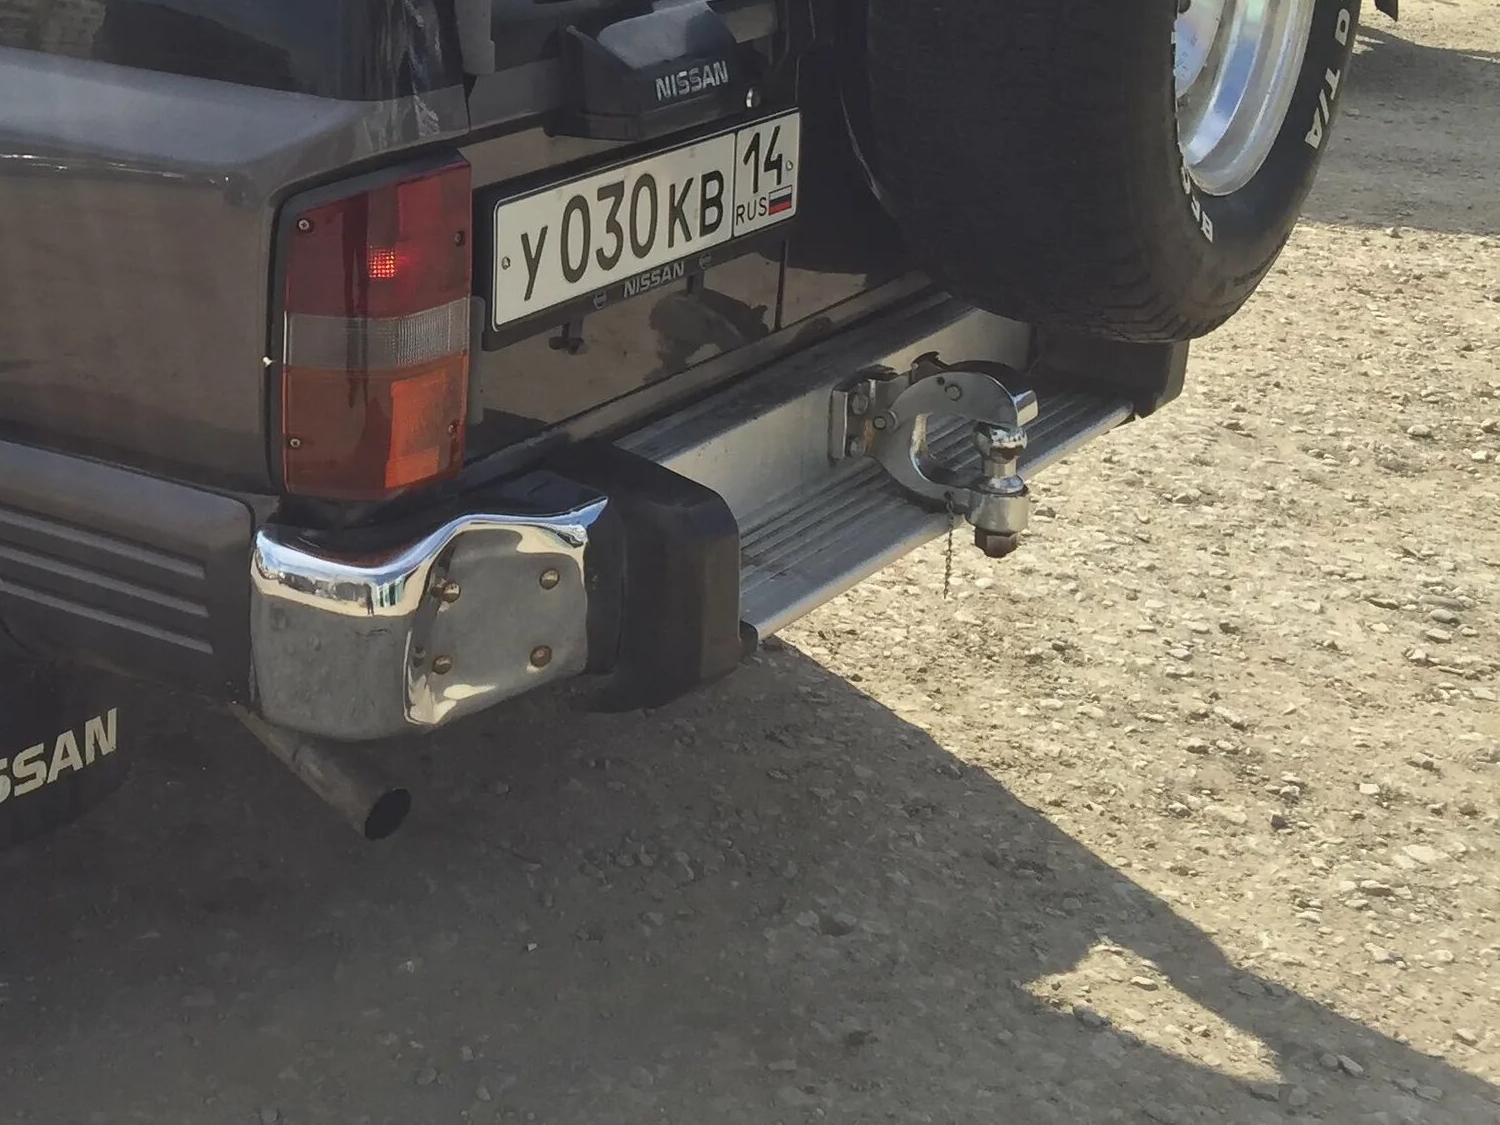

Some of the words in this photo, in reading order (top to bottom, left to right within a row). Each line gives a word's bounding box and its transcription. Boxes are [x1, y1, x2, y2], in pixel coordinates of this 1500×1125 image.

[655, 60, 729, 102] NISSAN
[1304, 67, 1341, 150] T/A
[743, 125, 783, 195] 14
[735, 197, 768, 226] RUS
[623, 261, 685, 298] NISSAN
